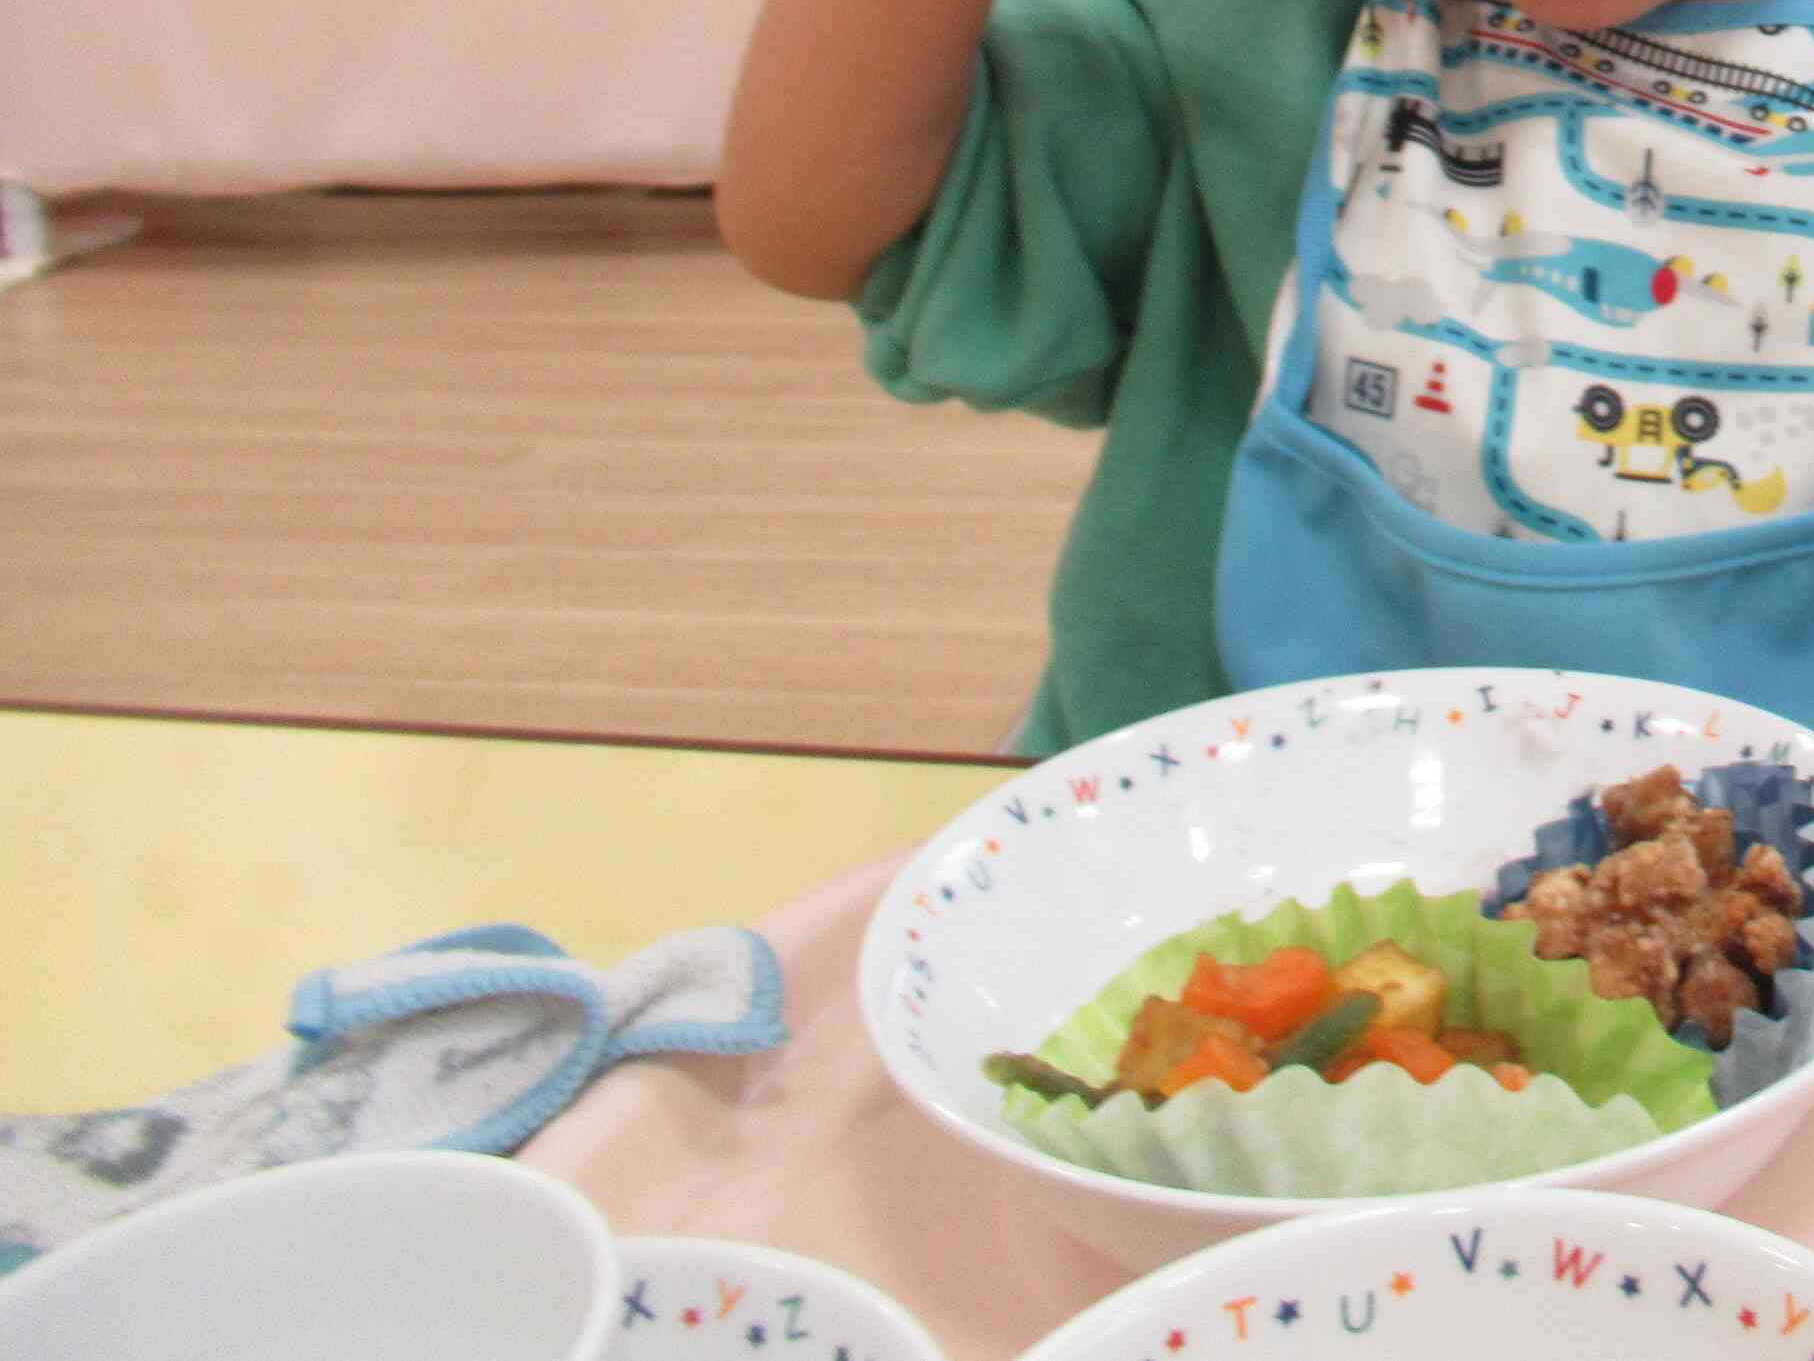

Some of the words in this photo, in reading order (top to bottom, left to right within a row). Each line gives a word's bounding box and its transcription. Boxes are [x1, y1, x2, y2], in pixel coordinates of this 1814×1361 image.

[1352, 371, 1386, 407] 45
[1004, 795, 1029, 826] V
[1068, 775, 1102, 804] W
[1148, 743, 1182, 778] X
[1395, 706, 1420, 736] H
[1476, 684, 1497, 714] I
[1553, 691, 1582, 720] J
[1634, 711, 1656, 740] K
[1704, 709, 1722, 743] L
[622, 1278, 657, 1330] X
[717, 1277, 746, 1321] Y
[776, 1294, 810, 1341] Z
[1221, 1295, 1258, 1341] T
[1340, 1291, 1375, 1333] U
[1450, 1227, 1483, 1274] V
[1552, 1238, 1604, 1289] W
[1674, 1263, 1713, 1308] X
[1781, 1291, 1811, 1336] Y
